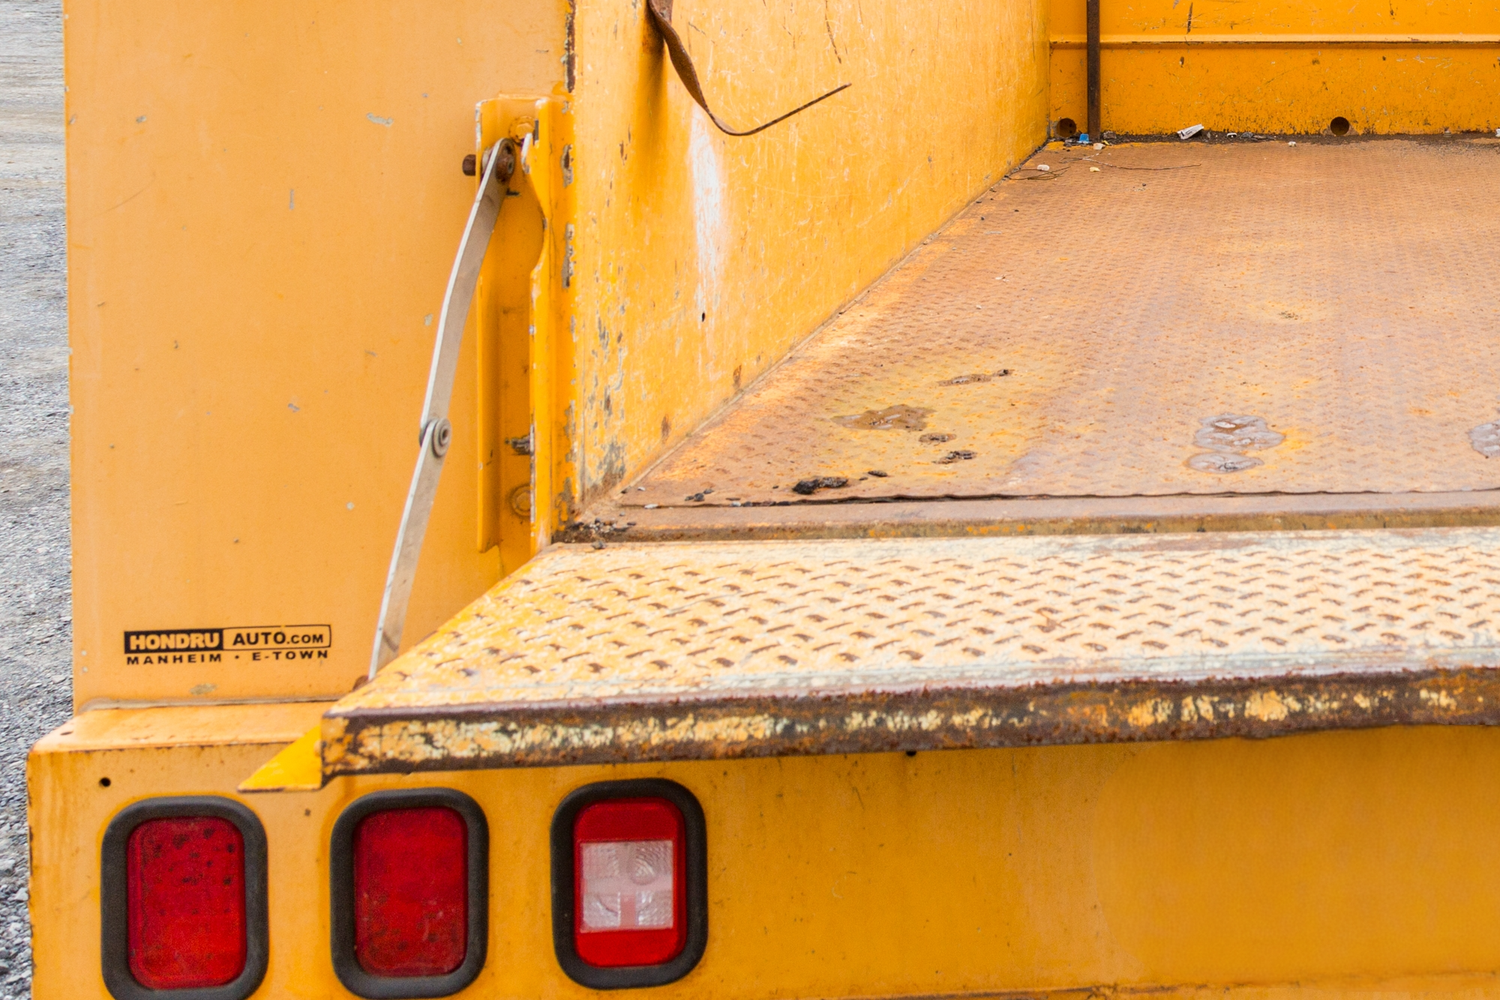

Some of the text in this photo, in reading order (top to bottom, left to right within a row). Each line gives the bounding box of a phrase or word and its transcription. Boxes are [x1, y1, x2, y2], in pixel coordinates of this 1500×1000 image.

[130, 632, 221, 651] HONDRU
[127, 650, 329, 666] MANHEIM E-TOWN
